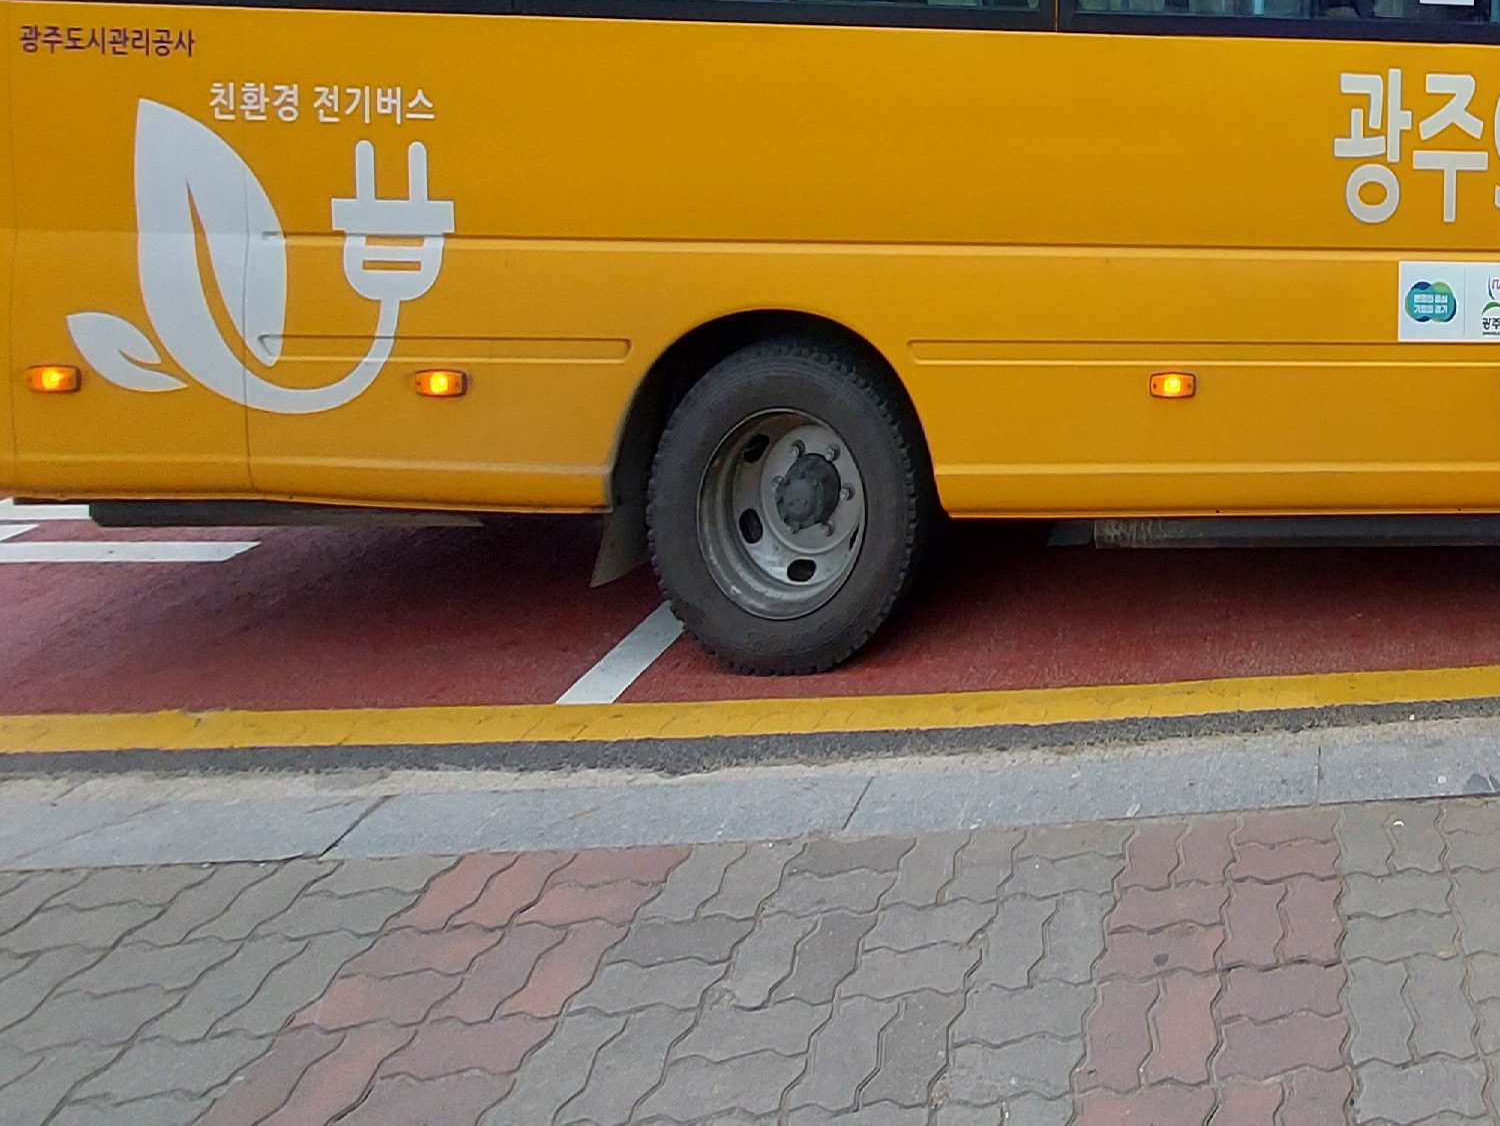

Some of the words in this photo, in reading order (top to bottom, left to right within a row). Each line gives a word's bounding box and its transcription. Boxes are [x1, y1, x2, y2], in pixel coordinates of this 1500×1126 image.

[19, 24, 196, 57] 광주도시관리공사
[209, 82, 300, 122] 친환경
[312, 85, 436, 125] 전기버스
